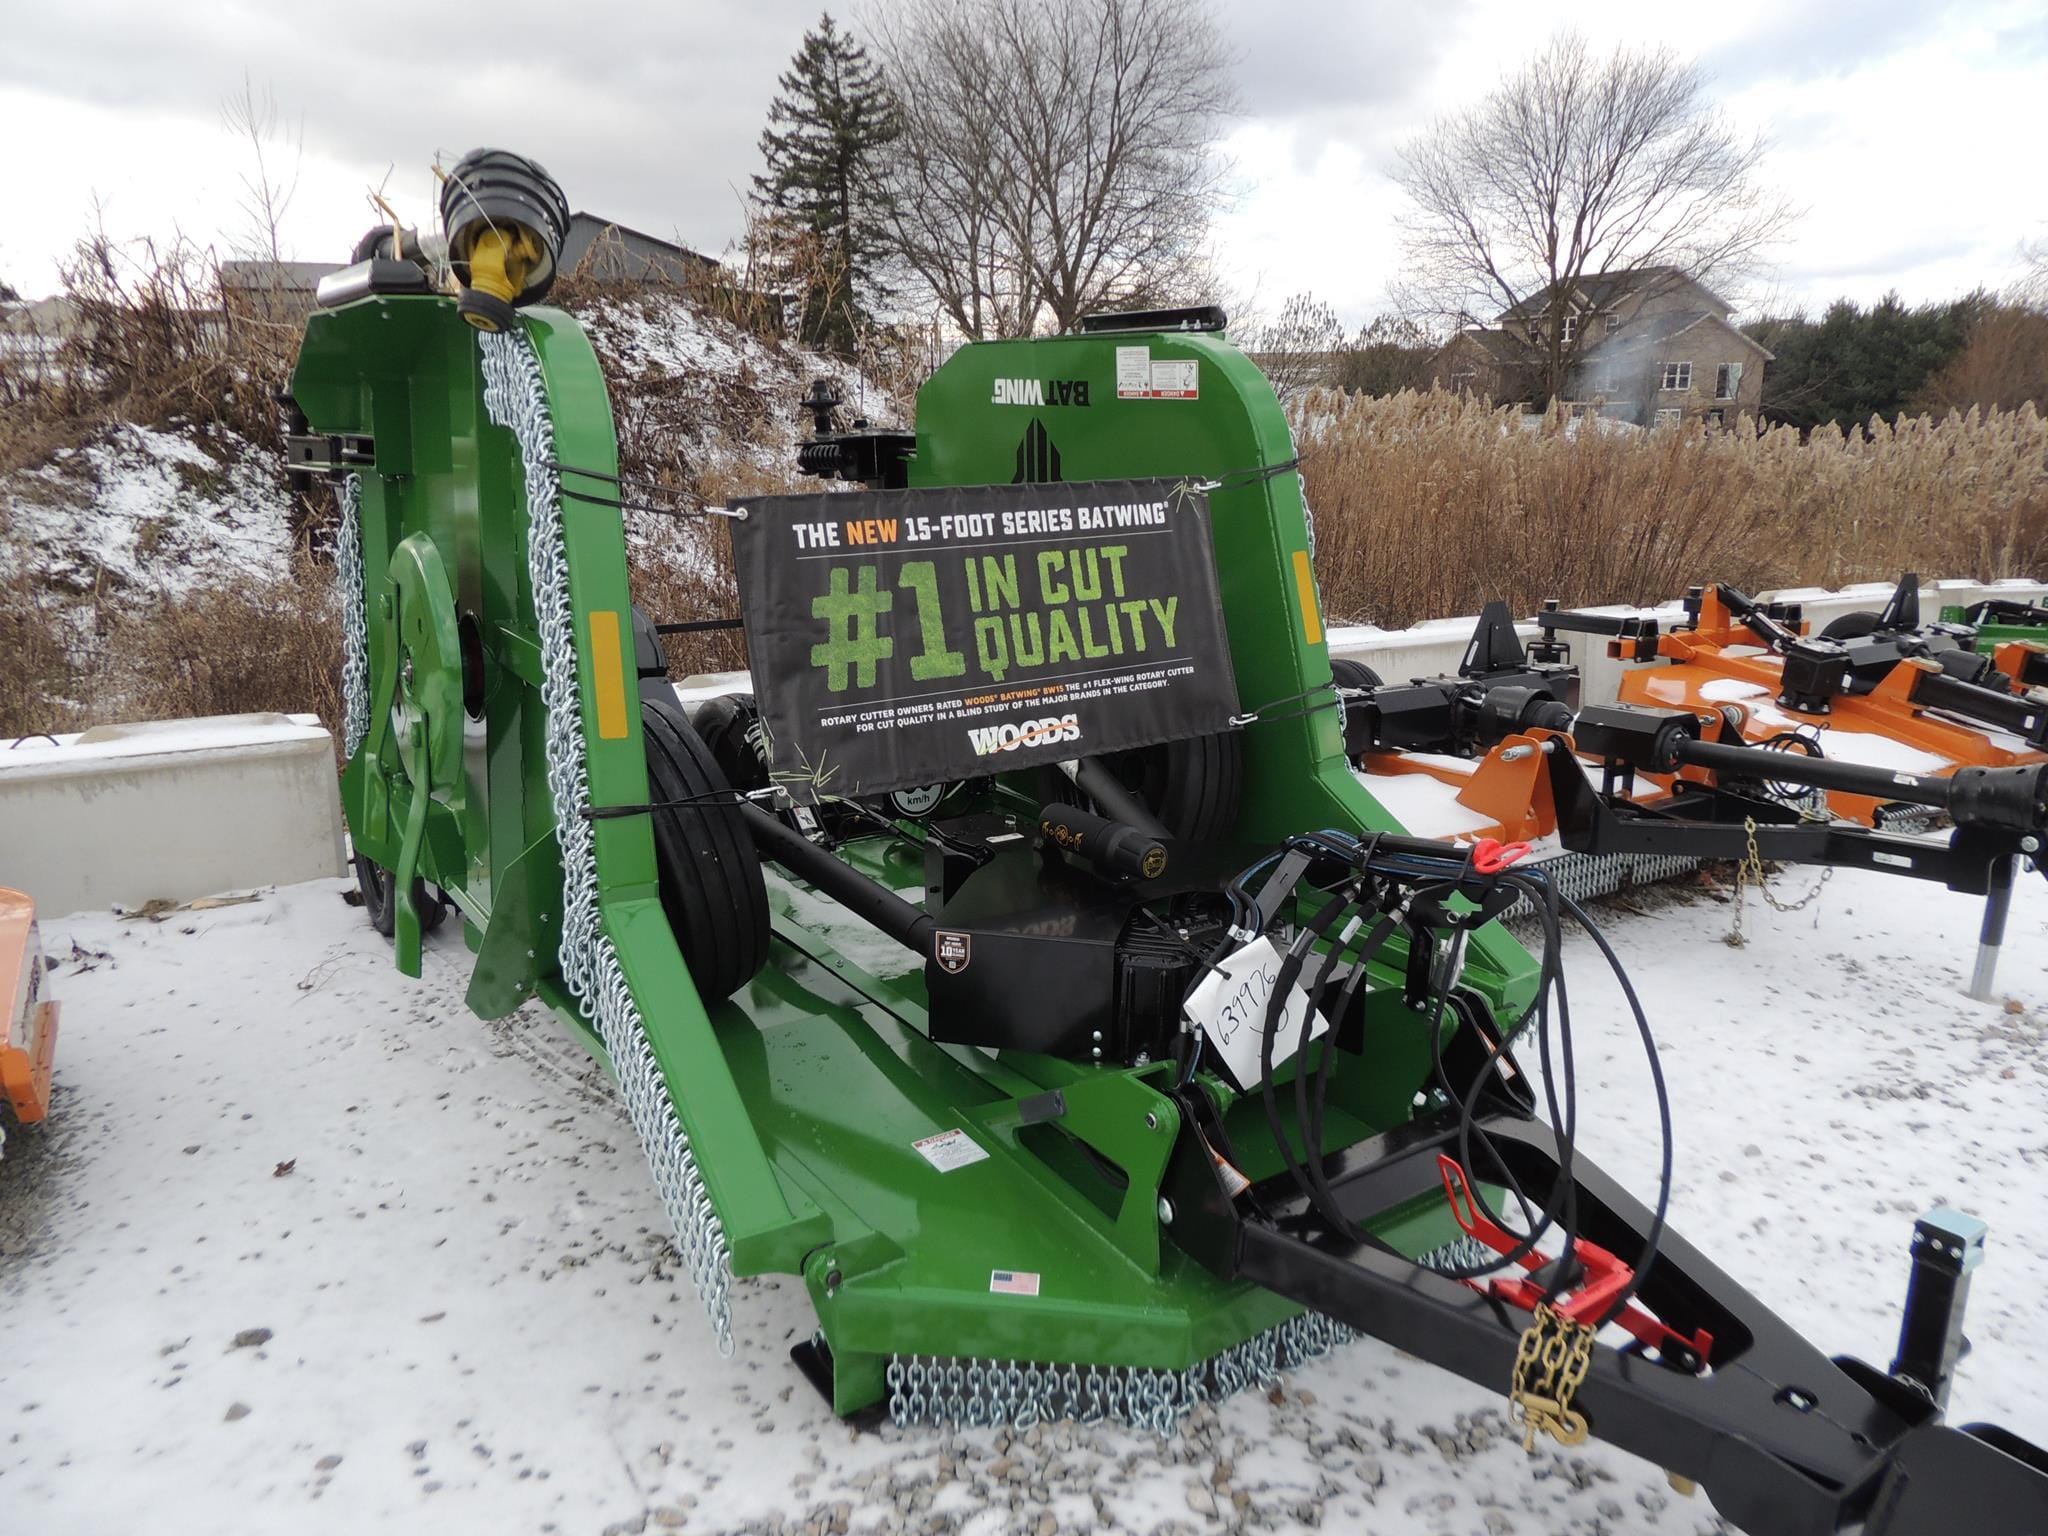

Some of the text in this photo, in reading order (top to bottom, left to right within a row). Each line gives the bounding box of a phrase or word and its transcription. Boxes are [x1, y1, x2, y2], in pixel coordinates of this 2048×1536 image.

[792, 522, 841, 548] THE
[846, 519, 897, 545] NEW
[905, 513, 995, 541] 15-FOOT
[1002, 509, 1073, 535] SERIES
[965, 545, 1128, 612] IN CUT
[811, 560, 966, 692] #1
[974, 596, 1178, 682] QUALITY
[821, 714, 857, 727] ROTARY
[860, 709, 895, 721] CUTTER
[897, 704, 934, 716] OWNERS
[936, 699, 962, 710] RATED
[1043, 684, 1064, 695] BW15
[1065, 682, 1080, 691] THE
[1083, 681, 1092, 689] #1
[1093, 674, 1135, 687] FLEX-WING
[1136, 670, 1165, 681] ROTARY
[1167, 666, 1195, 677] CUTTER
[856, 679, 1170, 733] FOR CUT QUALITY IN A BLIND STUDY OF THE MAJOR BRANDS IN THE CATEGORY.
[968, 713, 1080, 757] WOODS
[907, 794, 930, 806] km/h
[940, 946, 952, 957] 10
[1216, 962, 1276, 1046] 639976
